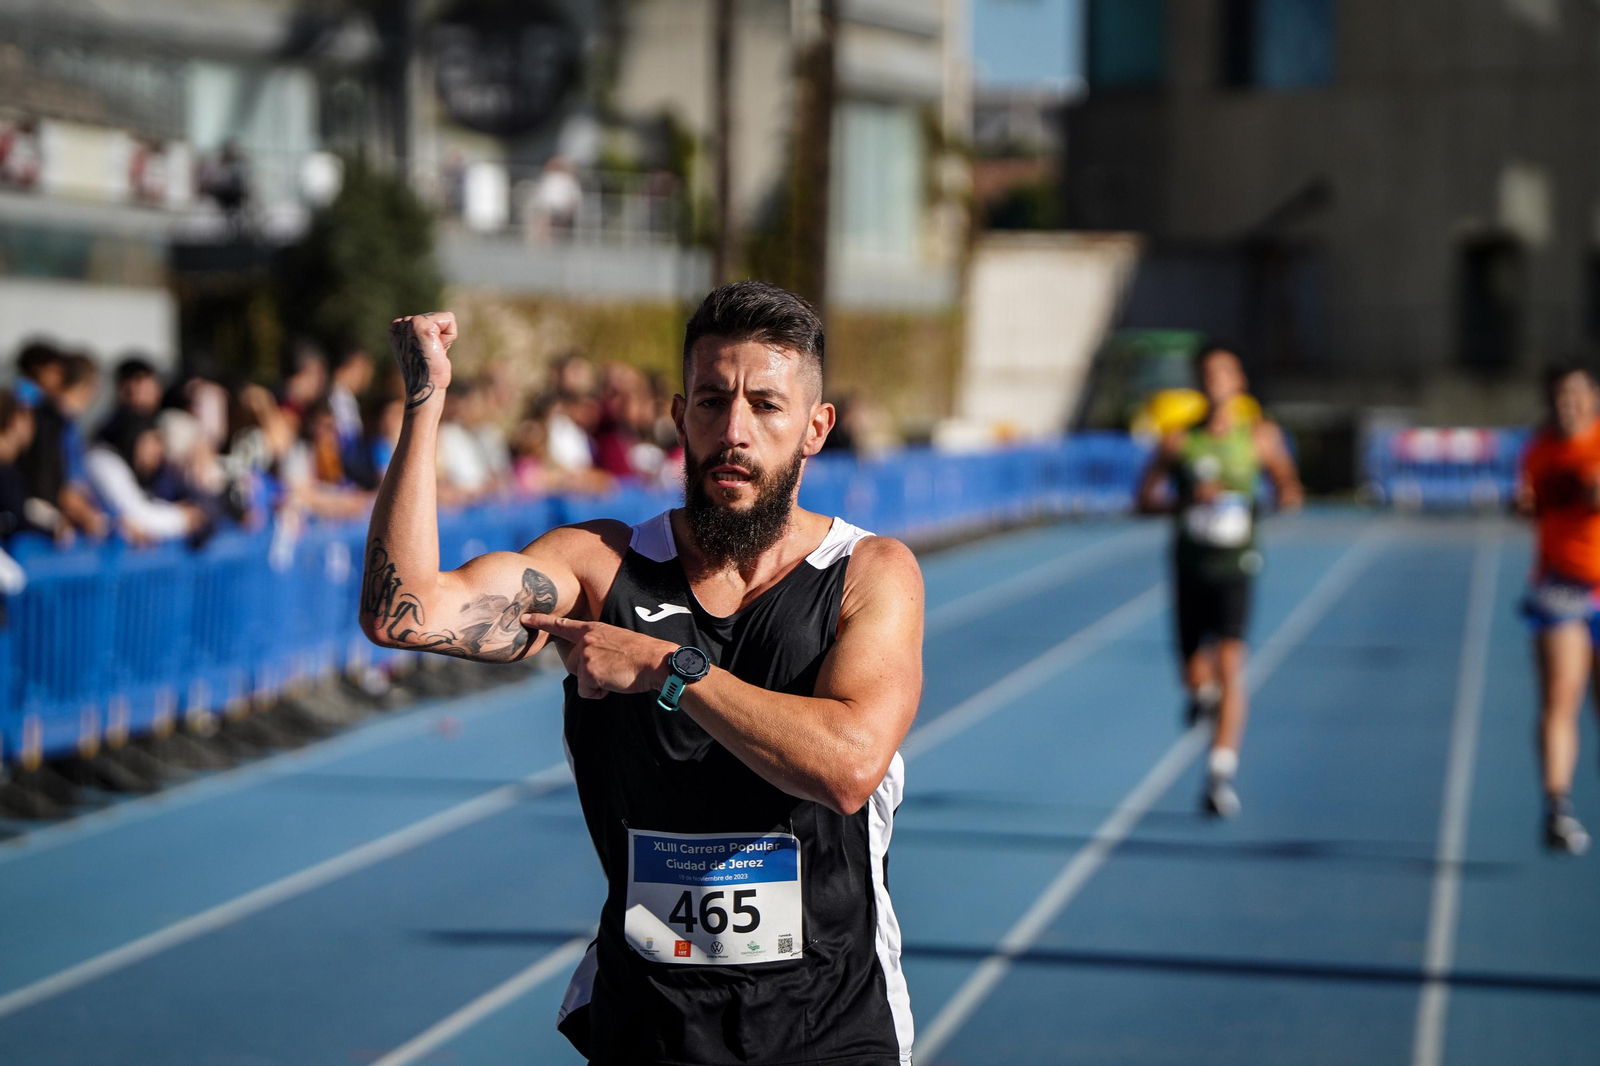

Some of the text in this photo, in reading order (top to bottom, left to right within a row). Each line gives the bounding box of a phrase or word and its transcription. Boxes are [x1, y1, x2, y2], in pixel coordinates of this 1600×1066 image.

[653, 841, 780, 854] XLIII Carrera Popular
[666, 858, 764, 871] Ciudad de Jerez
[668, 889, 761, 935] 465
